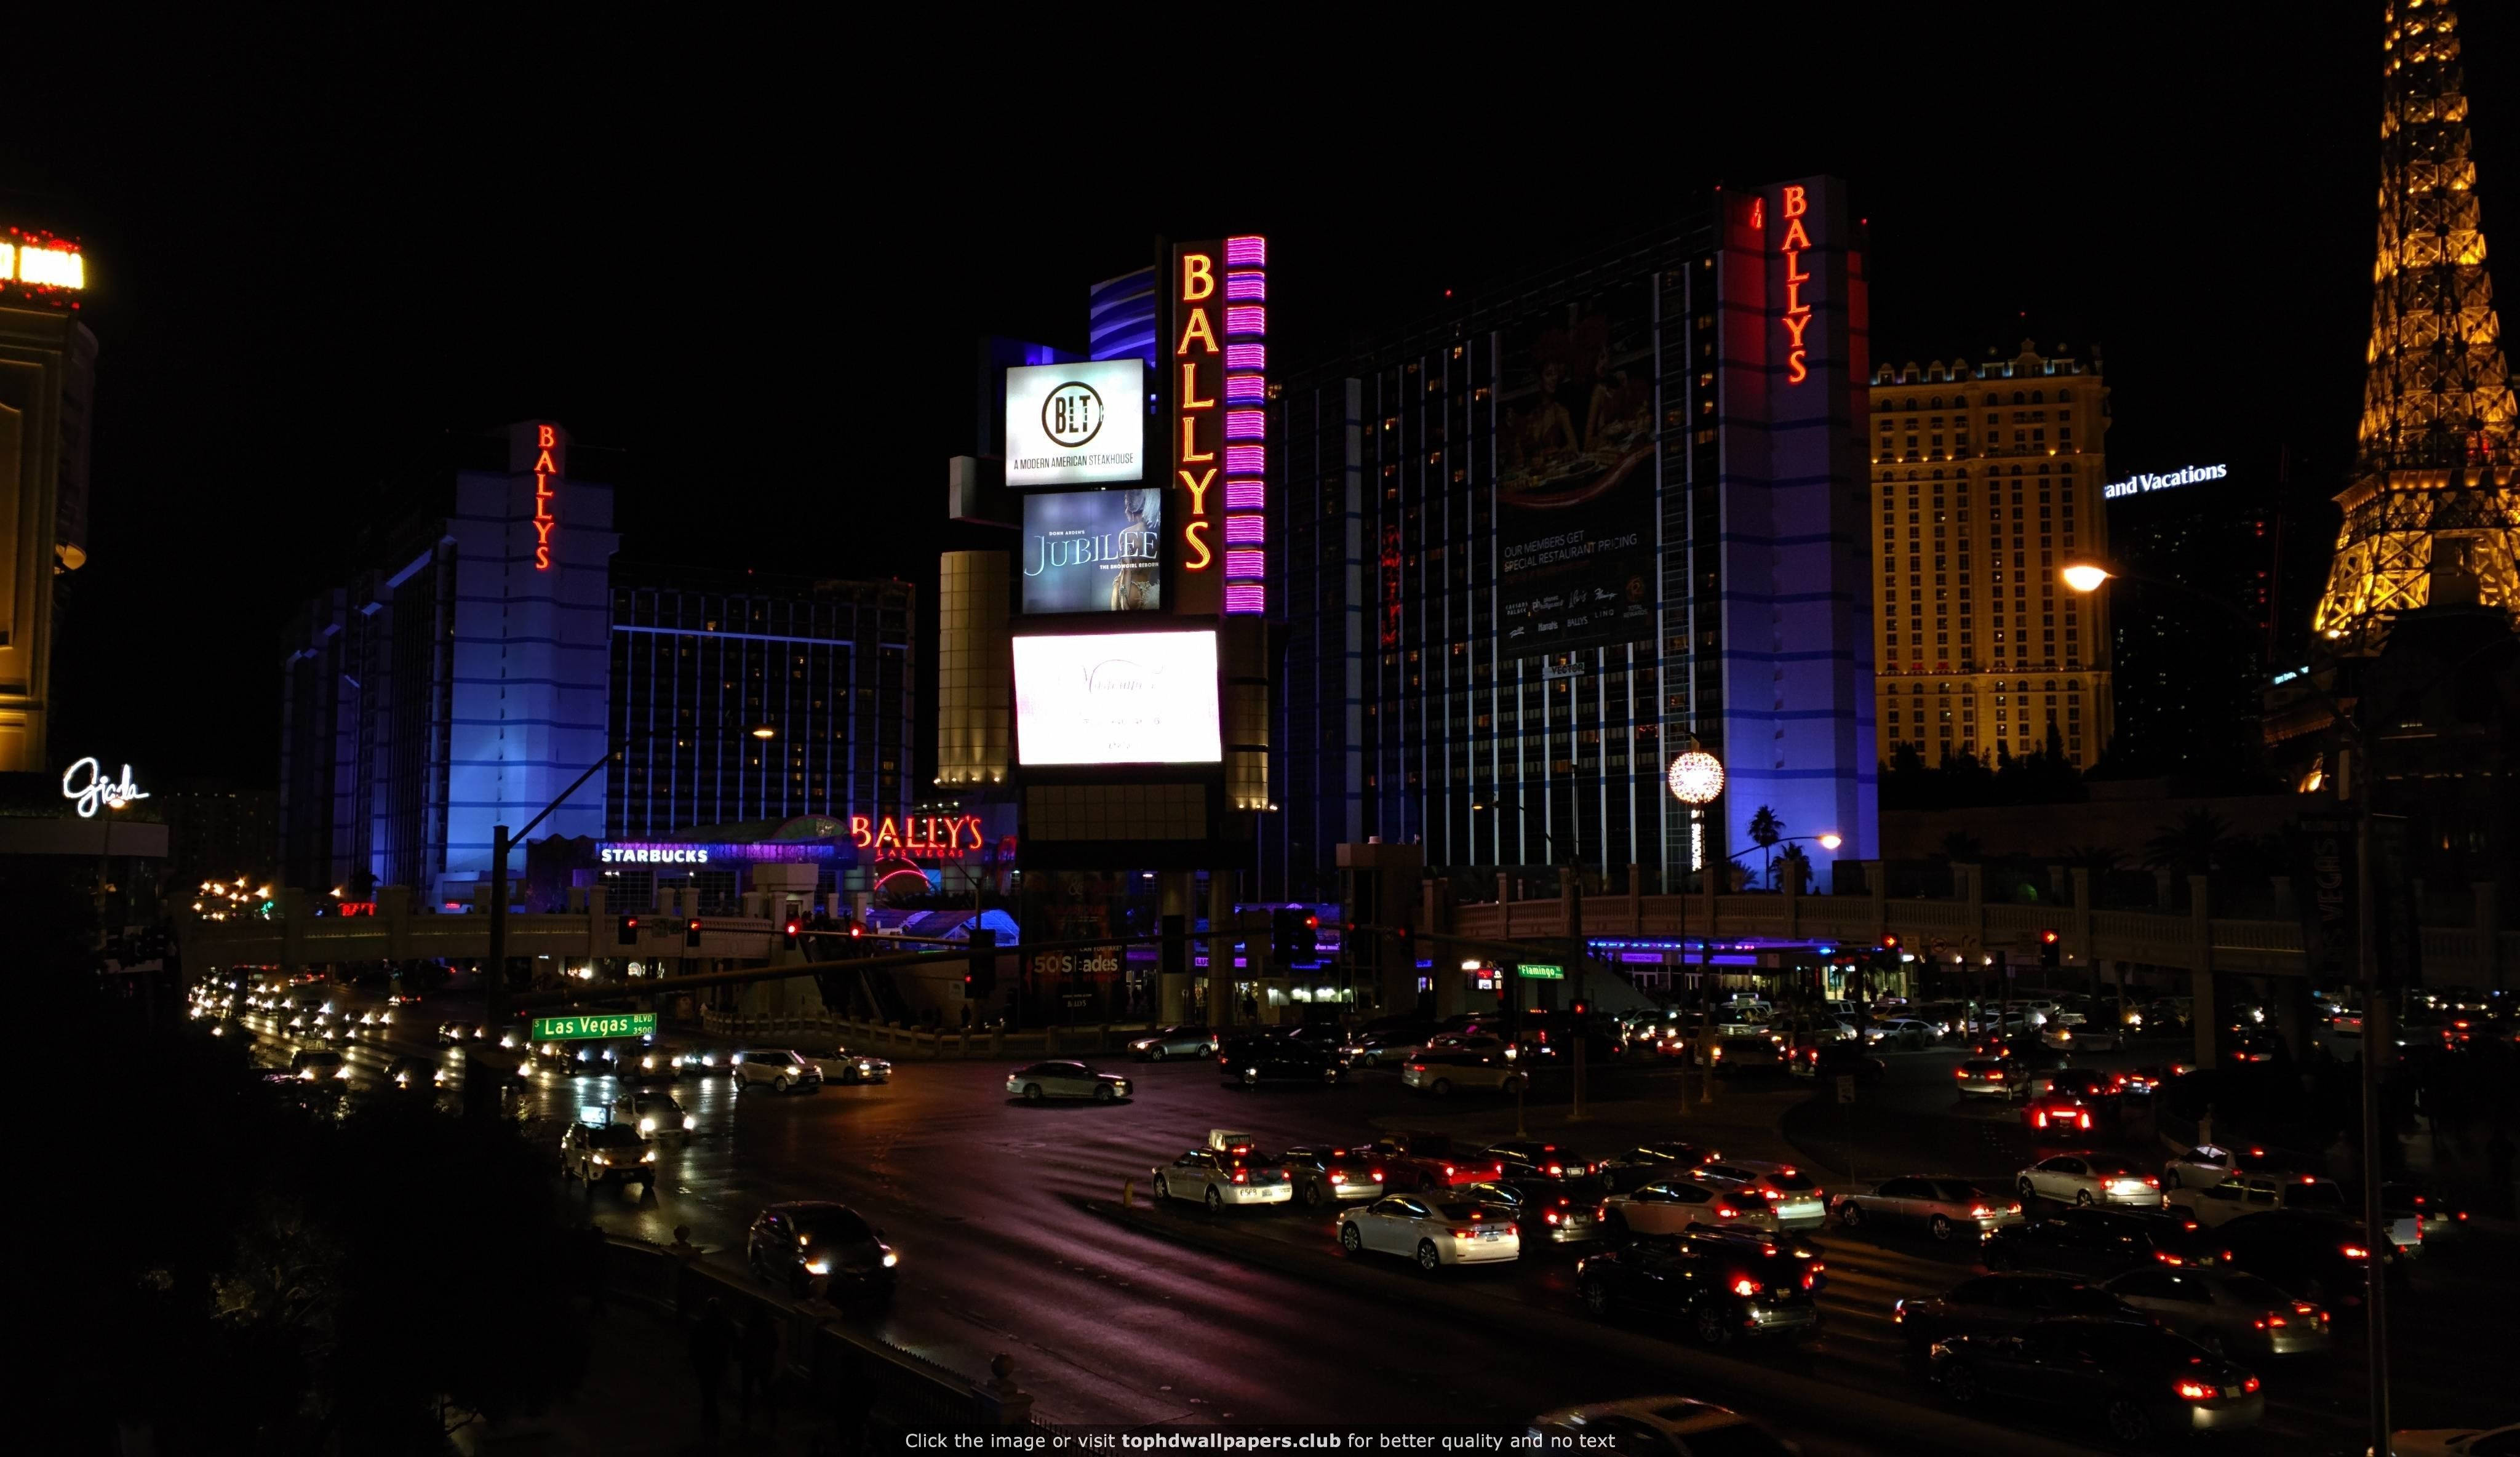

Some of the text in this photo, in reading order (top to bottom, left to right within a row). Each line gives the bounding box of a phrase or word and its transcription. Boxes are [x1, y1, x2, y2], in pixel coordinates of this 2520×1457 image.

[1782, 186, 1811, 383] BALLYS
[1055, 395, 1090, 434] BLT
[1178, 255, 1219, 569] BALLYS
[1014, 453, 1133, 469] A MODERN AMERICAN STEAKHOUSE
[533, 425, 556, 569] BALLYS
[2105, 463, 2227, 498] and Vacations
[1024, 529, 1158, 577] JUBILEE
[1504, 529, 1585, 558] OUR MEMBERS GET
[1504, 532, 1638, 572] SPECIAL RESTAURANT PRICING
[63, 757, 150, 818] Giada
[851, 815, 983, 849] BALLY'S
[601, 848, 708, 863] STARBUCKS
[1522, 967, 1555, 978] Flamingo
[545, 1020, 573, 1035] Las
[580, 1017, 628, 1036] Vegas
